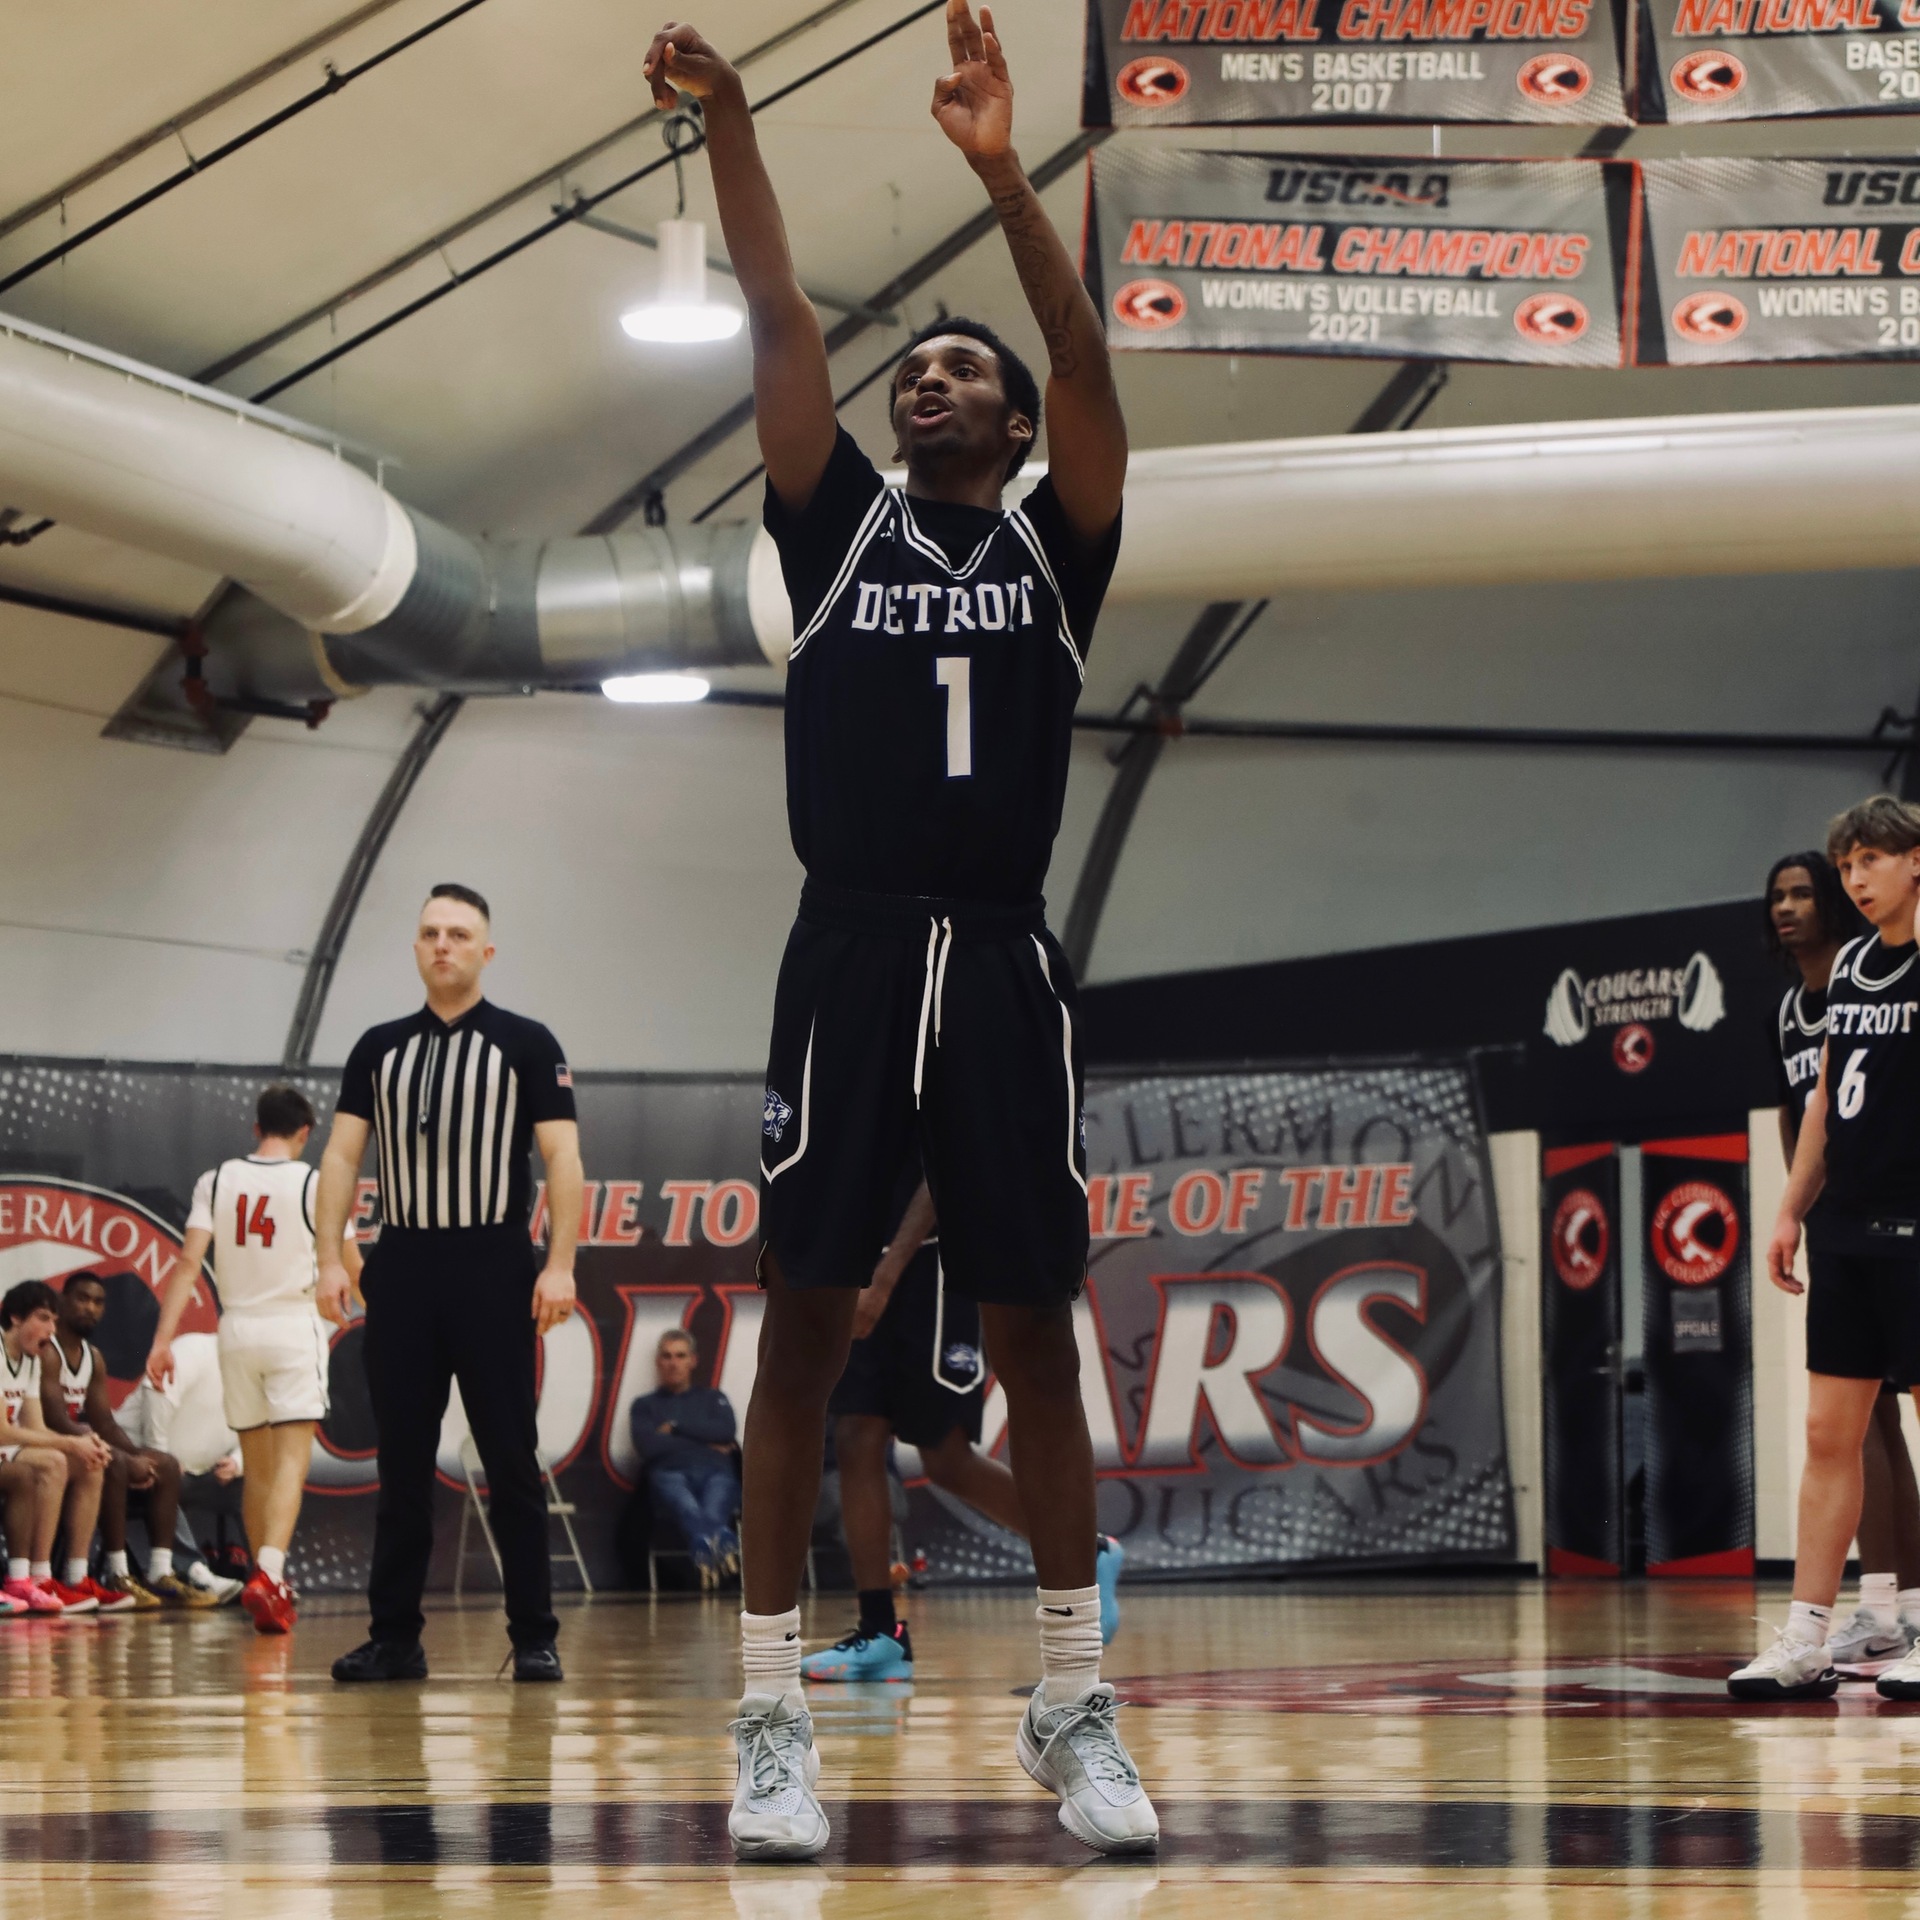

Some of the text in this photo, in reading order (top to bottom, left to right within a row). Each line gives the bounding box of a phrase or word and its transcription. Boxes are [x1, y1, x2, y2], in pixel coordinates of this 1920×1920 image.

[1120, 0, 1594, 42] NATIONAL CHAMPIONS
[1672, 0, 1882, 36] NATIONAL
[1220, 53, 1303, 82] MEN'S
[1312, 51, 1485, 80] BASKETBALL
[1311, 83, 1393, 111] 2007
[1266, 168, 1449, 208] USCAA
[1121, 219, 1592, 279] NATIONAL CHAMPIONS
[1675, 227, 1883, 278] NATIONAL
[1201, 279, 1331, 312] WOMEN'S
[1335, 284, 1500, 318] VOLLEYBALL
[1758, 285, 1890, 318] WOMEN'S
[1308, 313, 1381, 343] 2021
[851, 575, 1034, 635] DETROIT
[935, 656, 972, 778] 1
[1584, 966, 1687, 1007] COUGARS
[1837, 1048, 1870, 1120] 6
[236, 1193, 275, 1247] 14
[660, 1179, 760, 1246] TO
[1167, 1168, 1264, 1236] OF
[1279, 1163, 1417, 1231] THE
[0, 1192, 204, 1309] ERMON
